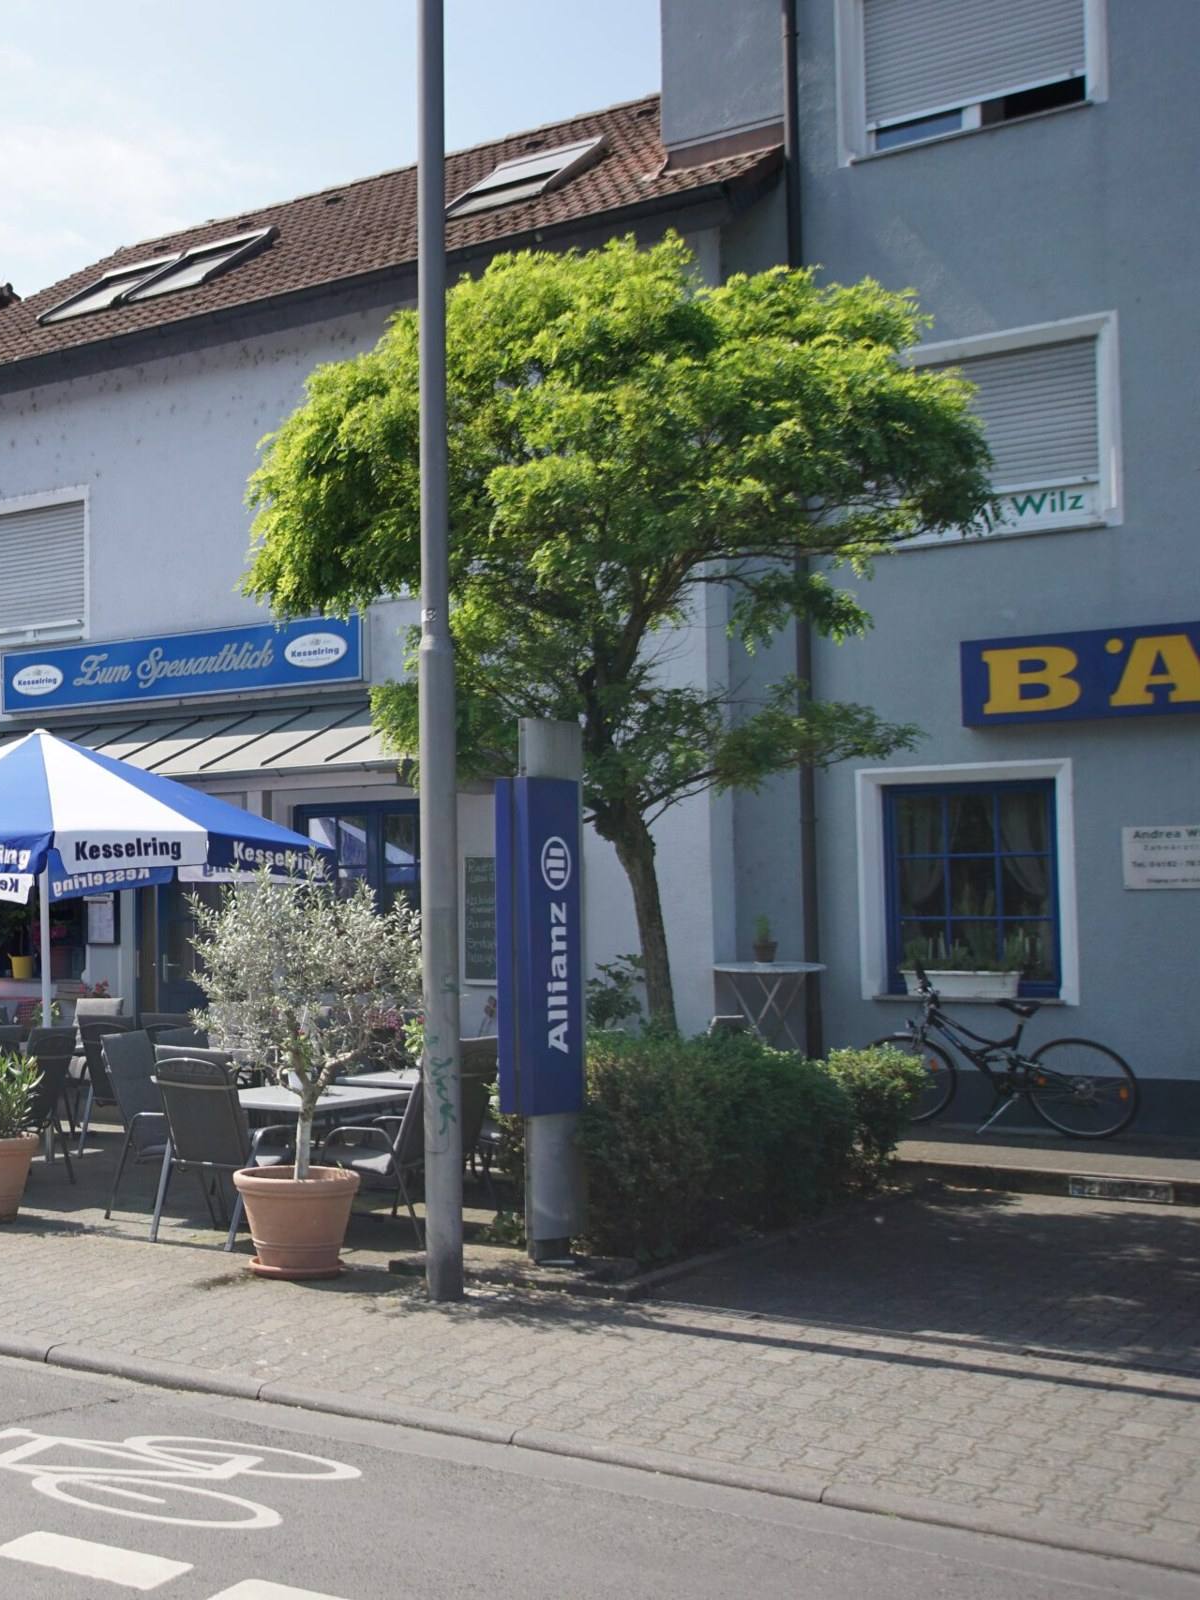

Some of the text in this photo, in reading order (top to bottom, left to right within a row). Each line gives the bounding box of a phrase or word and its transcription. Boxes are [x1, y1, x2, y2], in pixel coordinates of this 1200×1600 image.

[1011, 490, 1084, 517] Wilz
[73, 639, 274, 689] Zum Spessartblick
[291, 646, 340, 658] Kesselring
[17, 676, 58, 687] Kesselring
[75, 837, 181, 861] Kesselring
[547, 901, 570, 1054] Allianz
